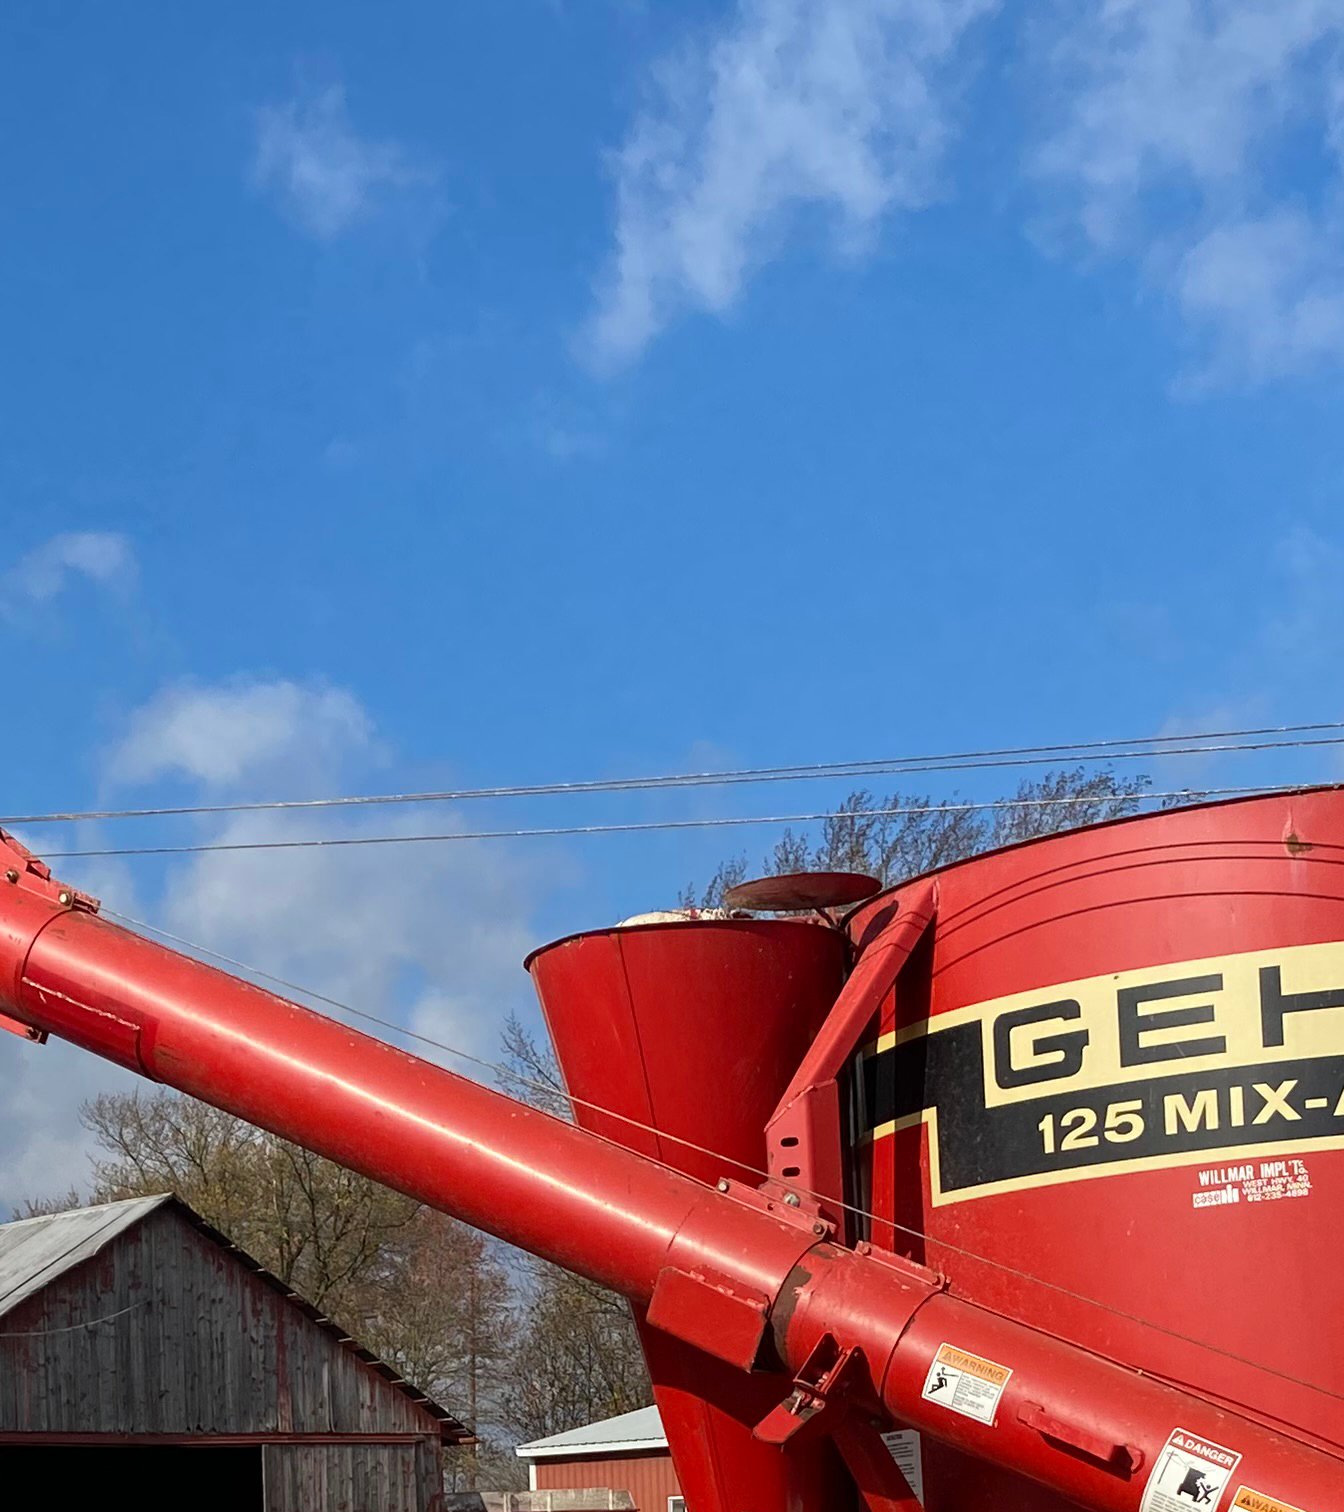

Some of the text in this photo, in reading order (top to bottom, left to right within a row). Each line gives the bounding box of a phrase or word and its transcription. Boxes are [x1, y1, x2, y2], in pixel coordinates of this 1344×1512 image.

[1037, 1099, 1145, 1154] 125
[1199, 1165, 1255, 1187] WILLMAR
[1242, 1178, 1269, 1188] WEST
[1296, 1173, 1309, 1182] 40
[950, 1354, 1005, 1381] WARNING
[1183, 1438, 1235, 1467] DANGER
